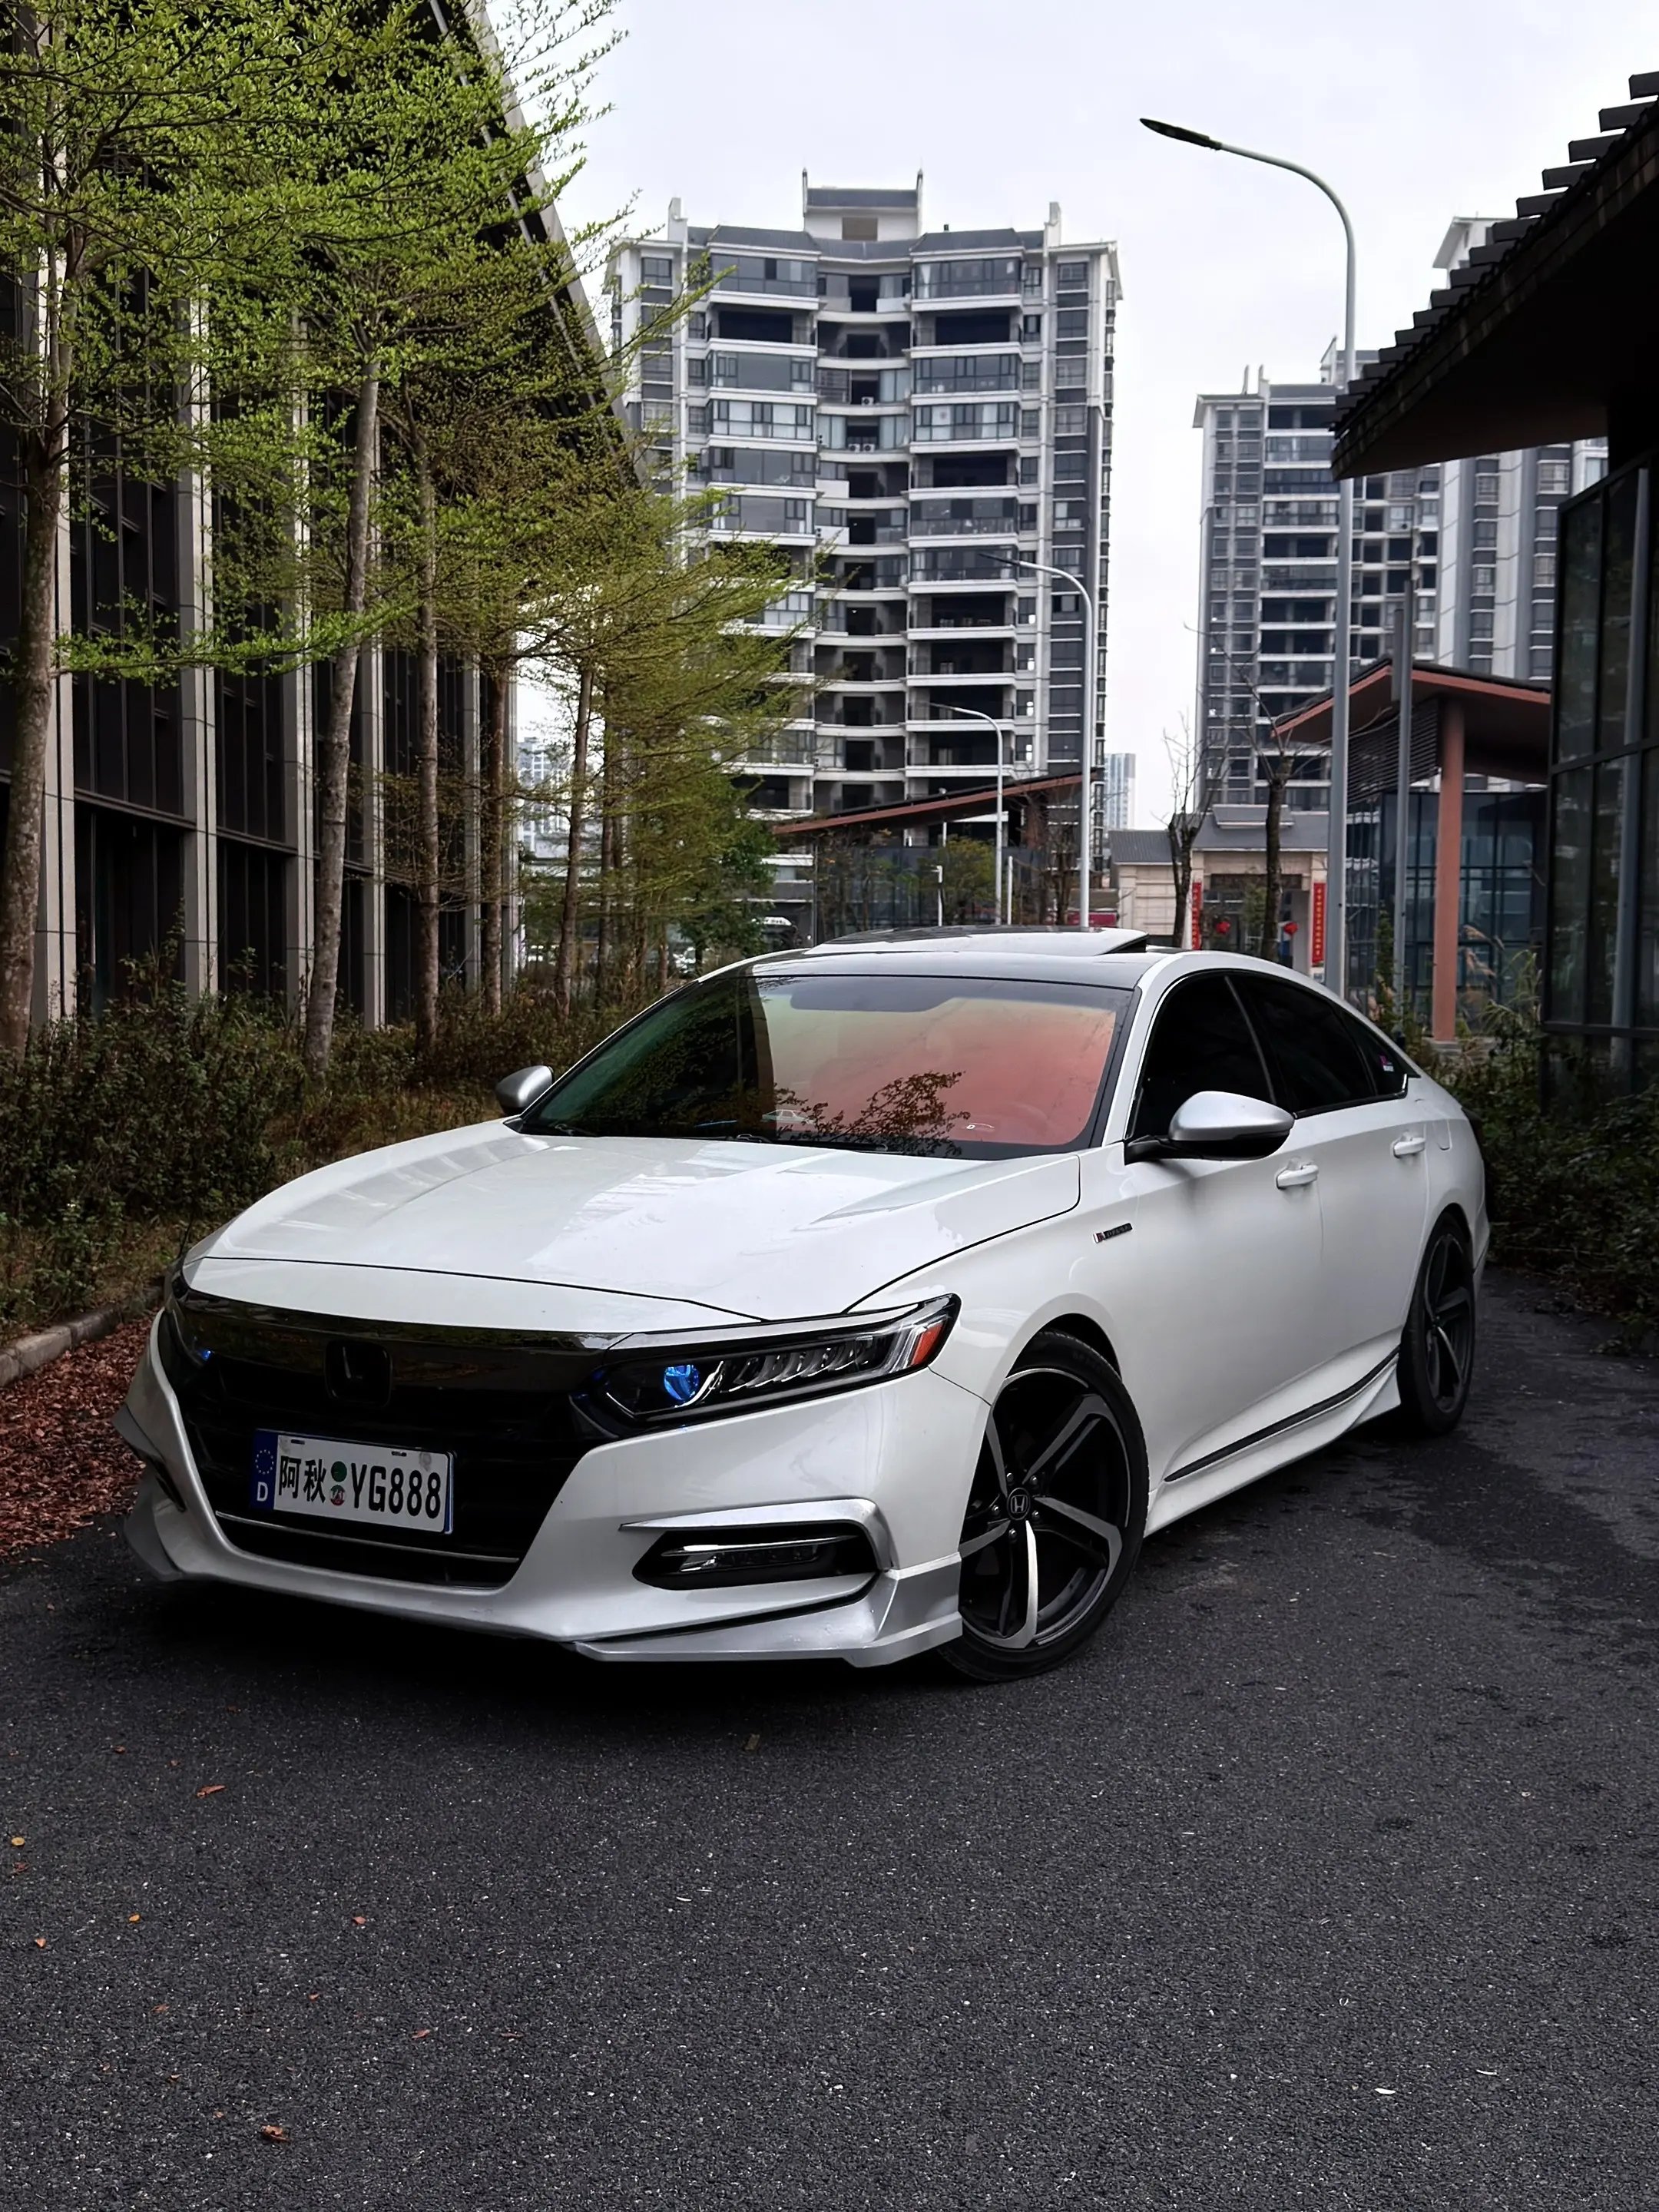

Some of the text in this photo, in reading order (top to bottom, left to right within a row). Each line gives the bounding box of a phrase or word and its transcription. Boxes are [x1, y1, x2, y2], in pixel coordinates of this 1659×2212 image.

[257, 1482, 268, 1502] D
[279, 1456, 326, 1503] 阿秋
[351, 1463, 441, 1518] YG888
